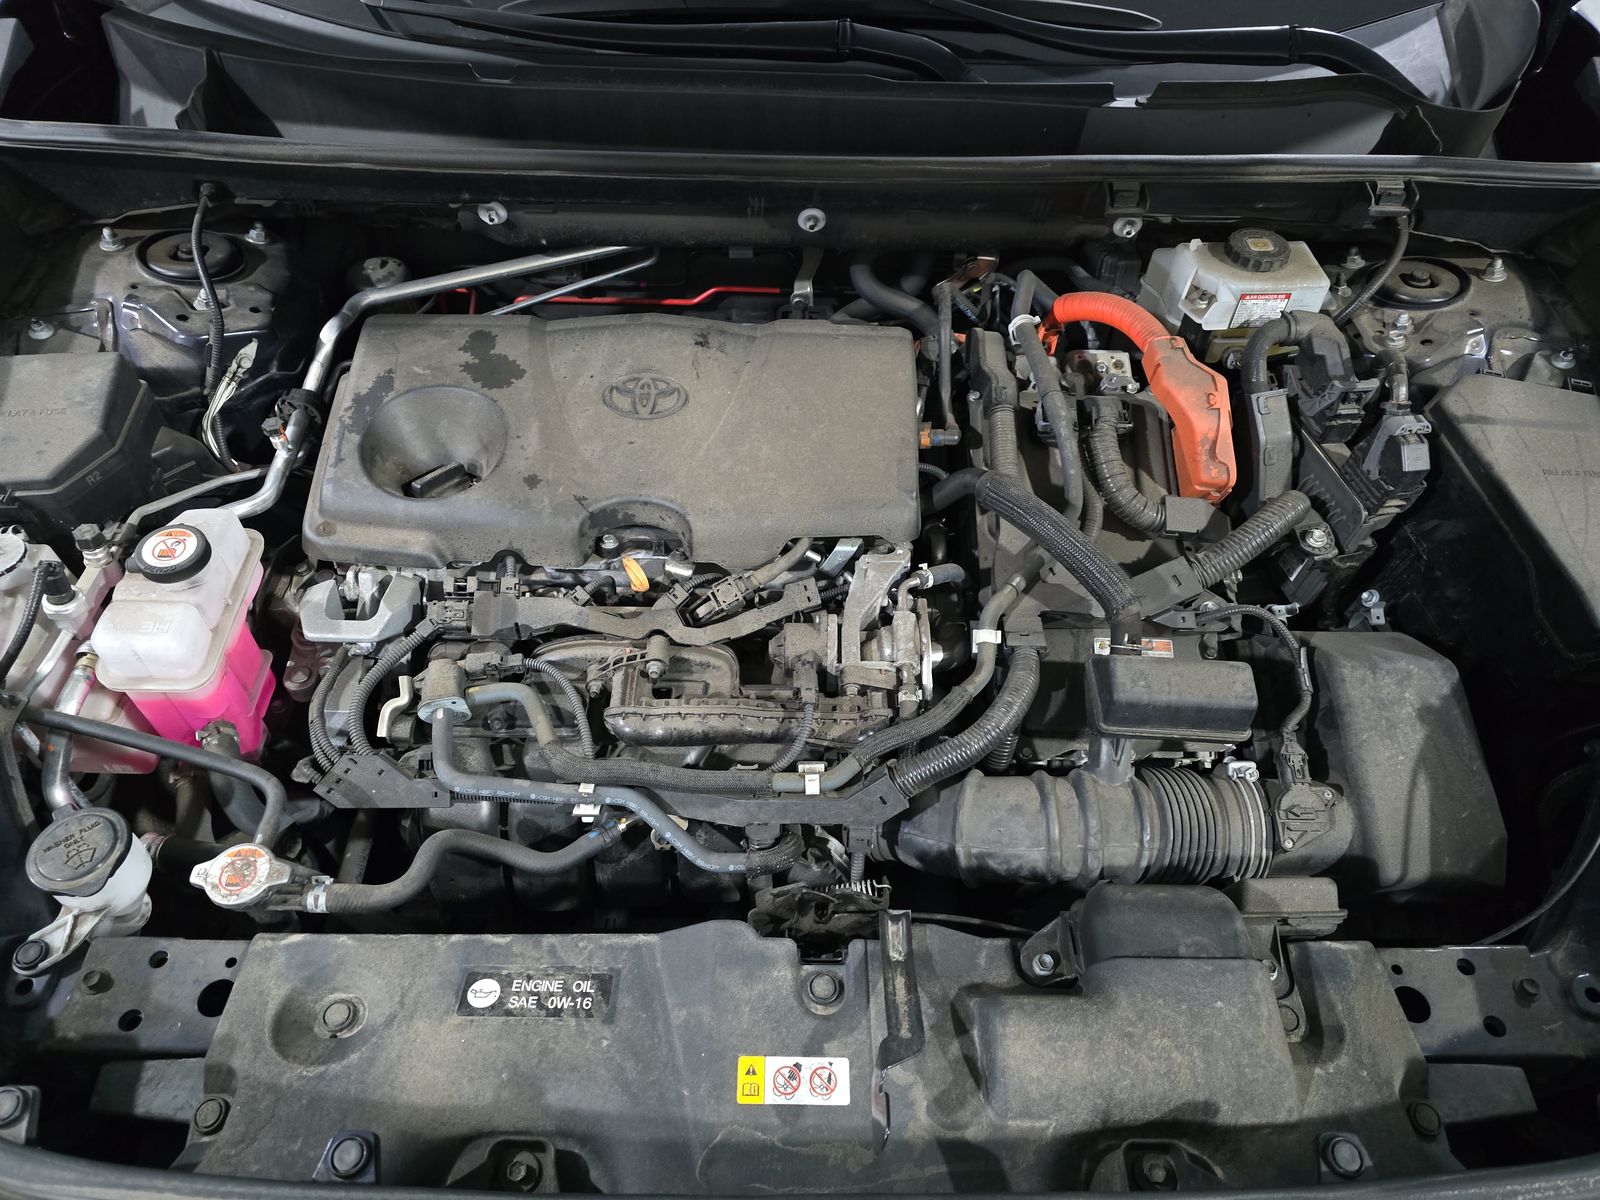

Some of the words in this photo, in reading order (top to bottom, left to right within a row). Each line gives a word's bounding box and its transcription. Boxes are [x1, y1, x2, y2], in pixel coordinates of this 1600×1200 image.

[39, 407, 68, 416] FUSE
[85, 470, 103, 486] R2
[78, 820, 101, 835] FLUID
[511, 979, 564, 992] ENGINE
[572, 980, 595, 993] OIL
[508, 996, 538, 1008] SAE
[547, 997, 593, 1009] 0W-16
